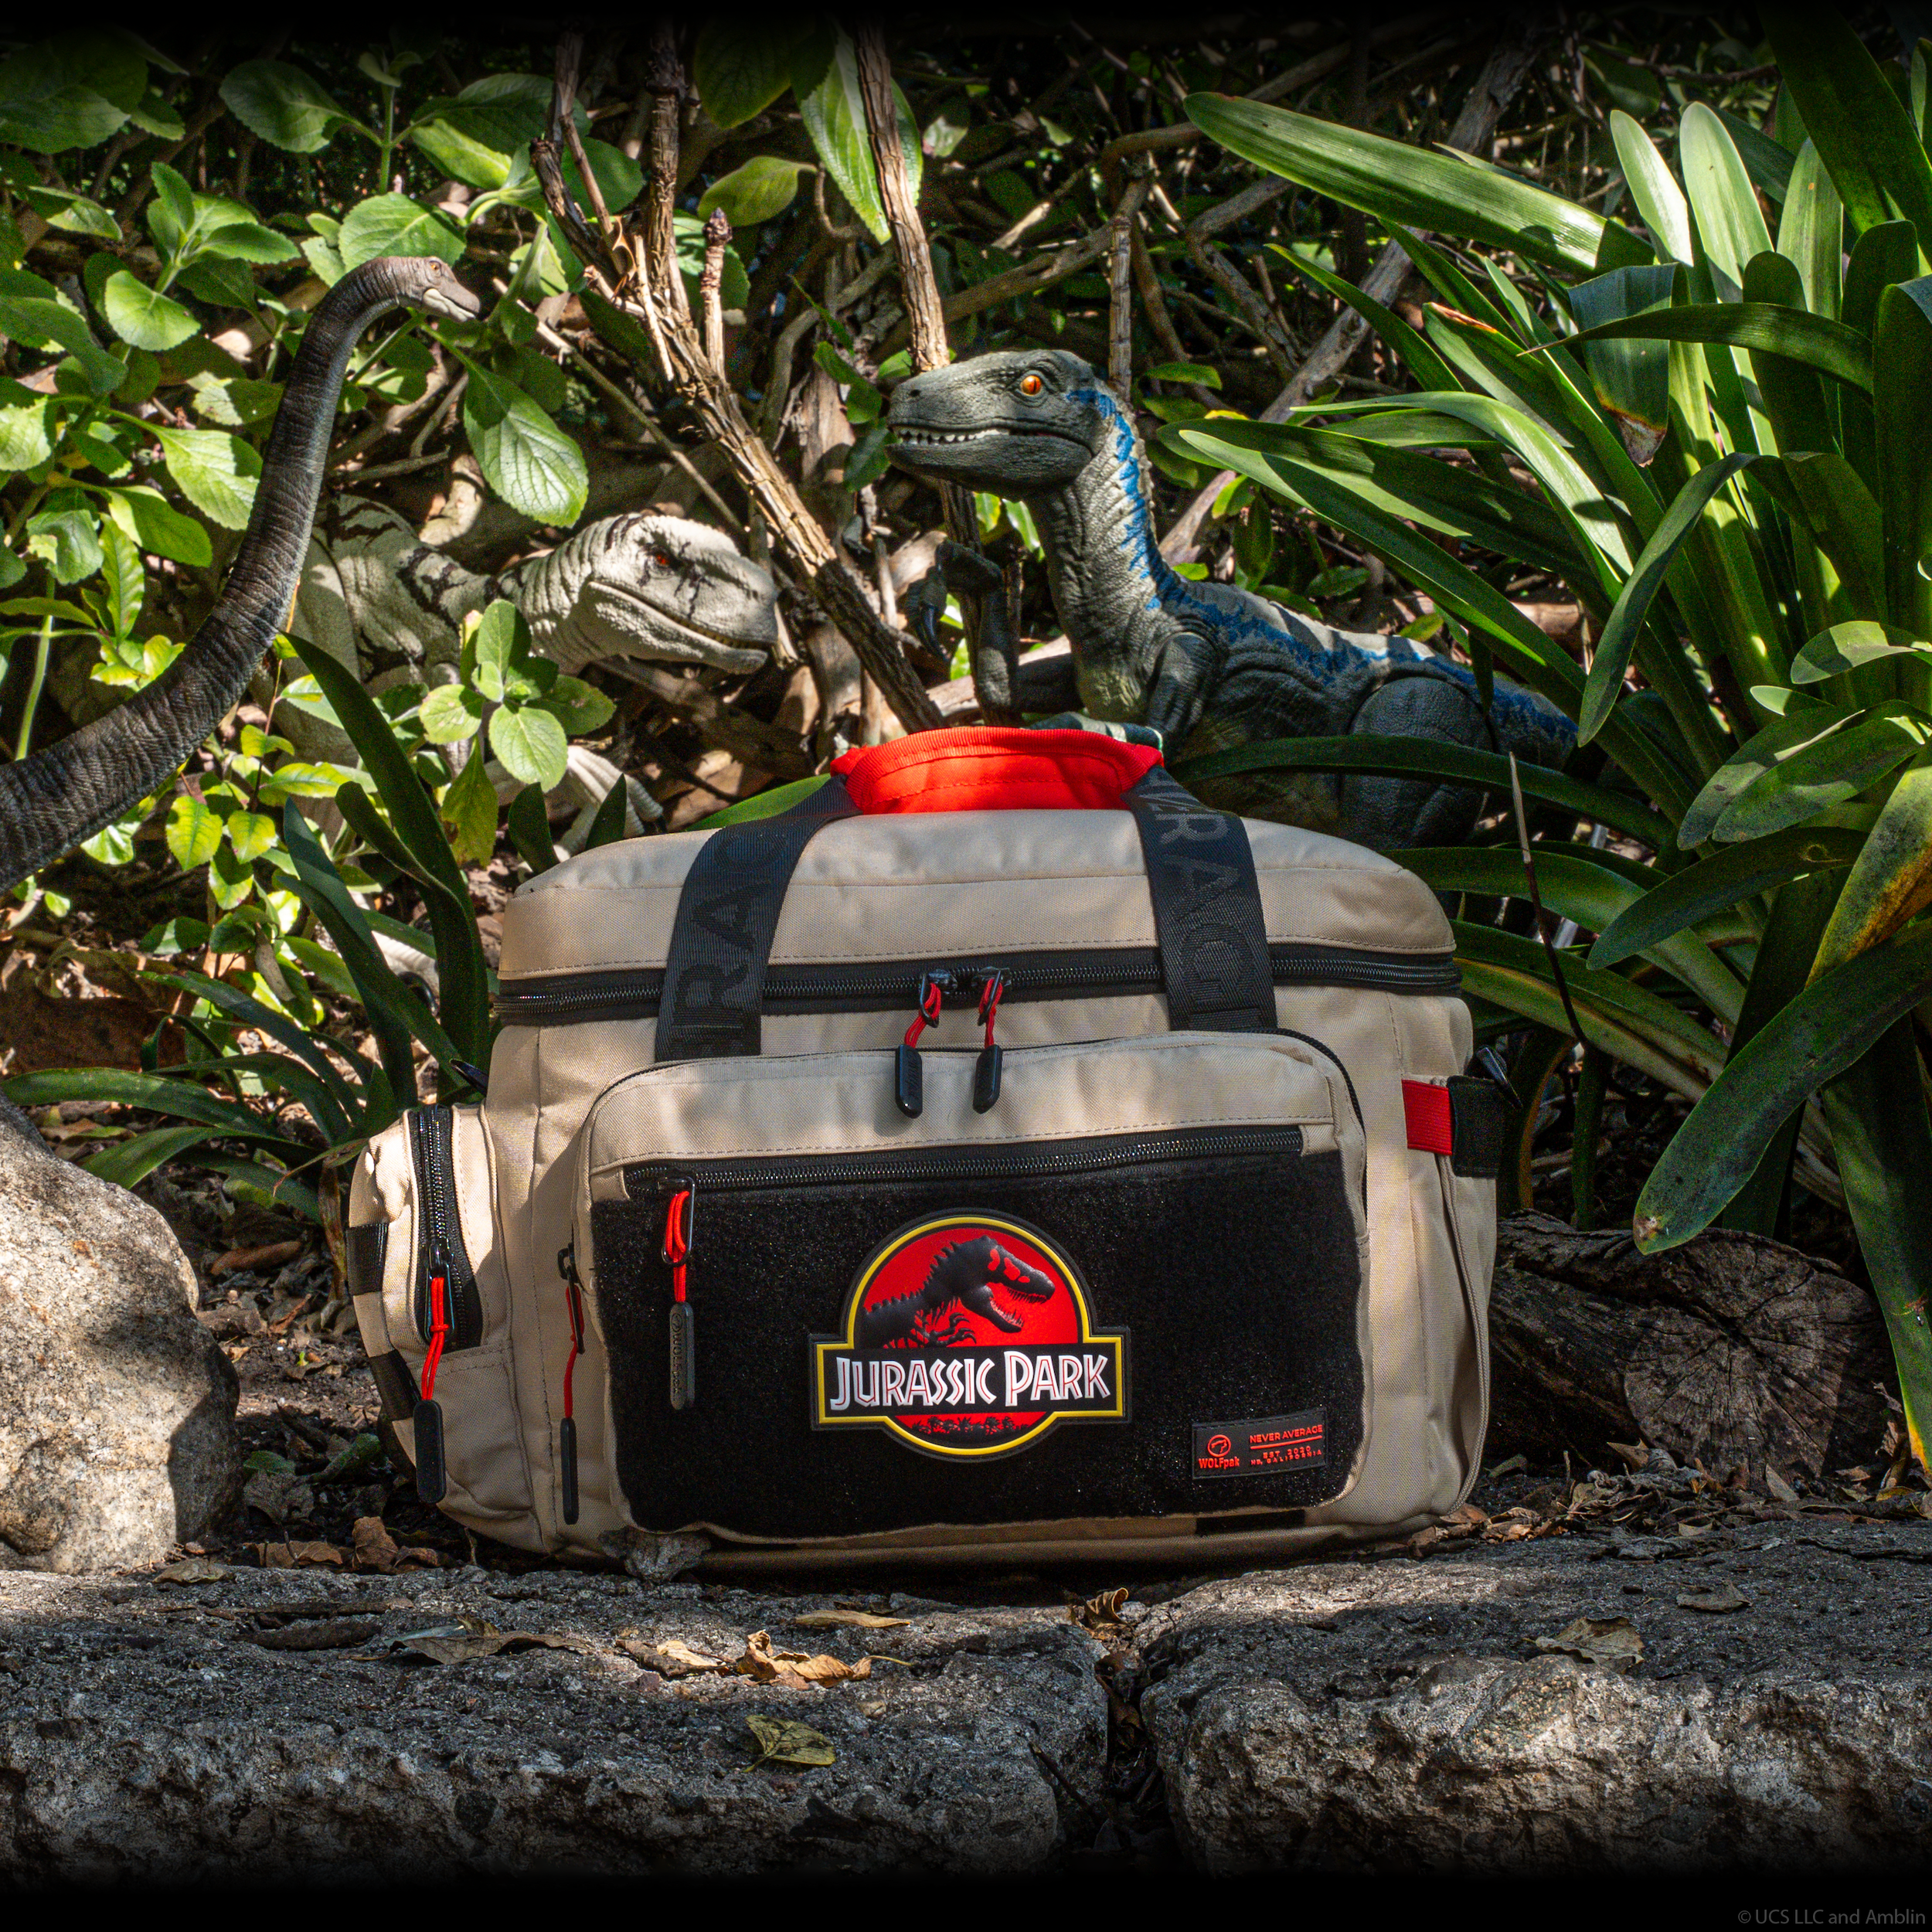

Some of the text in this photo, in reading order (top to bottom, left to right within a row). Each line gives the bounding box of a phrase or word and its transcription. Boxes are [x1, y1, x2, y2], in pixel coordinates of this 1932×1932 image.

[830, 1351, 1111, 1410] JURASSIC PARK
[1250, 1424, 1323, 1444] NEVER AVERAGE
[1263, 1451, 1281, 1459] EST
[1267, 1450, 1322, 1464] CALIFORNIA
[1199, 1456, 1240, 1469] WOLFpak
